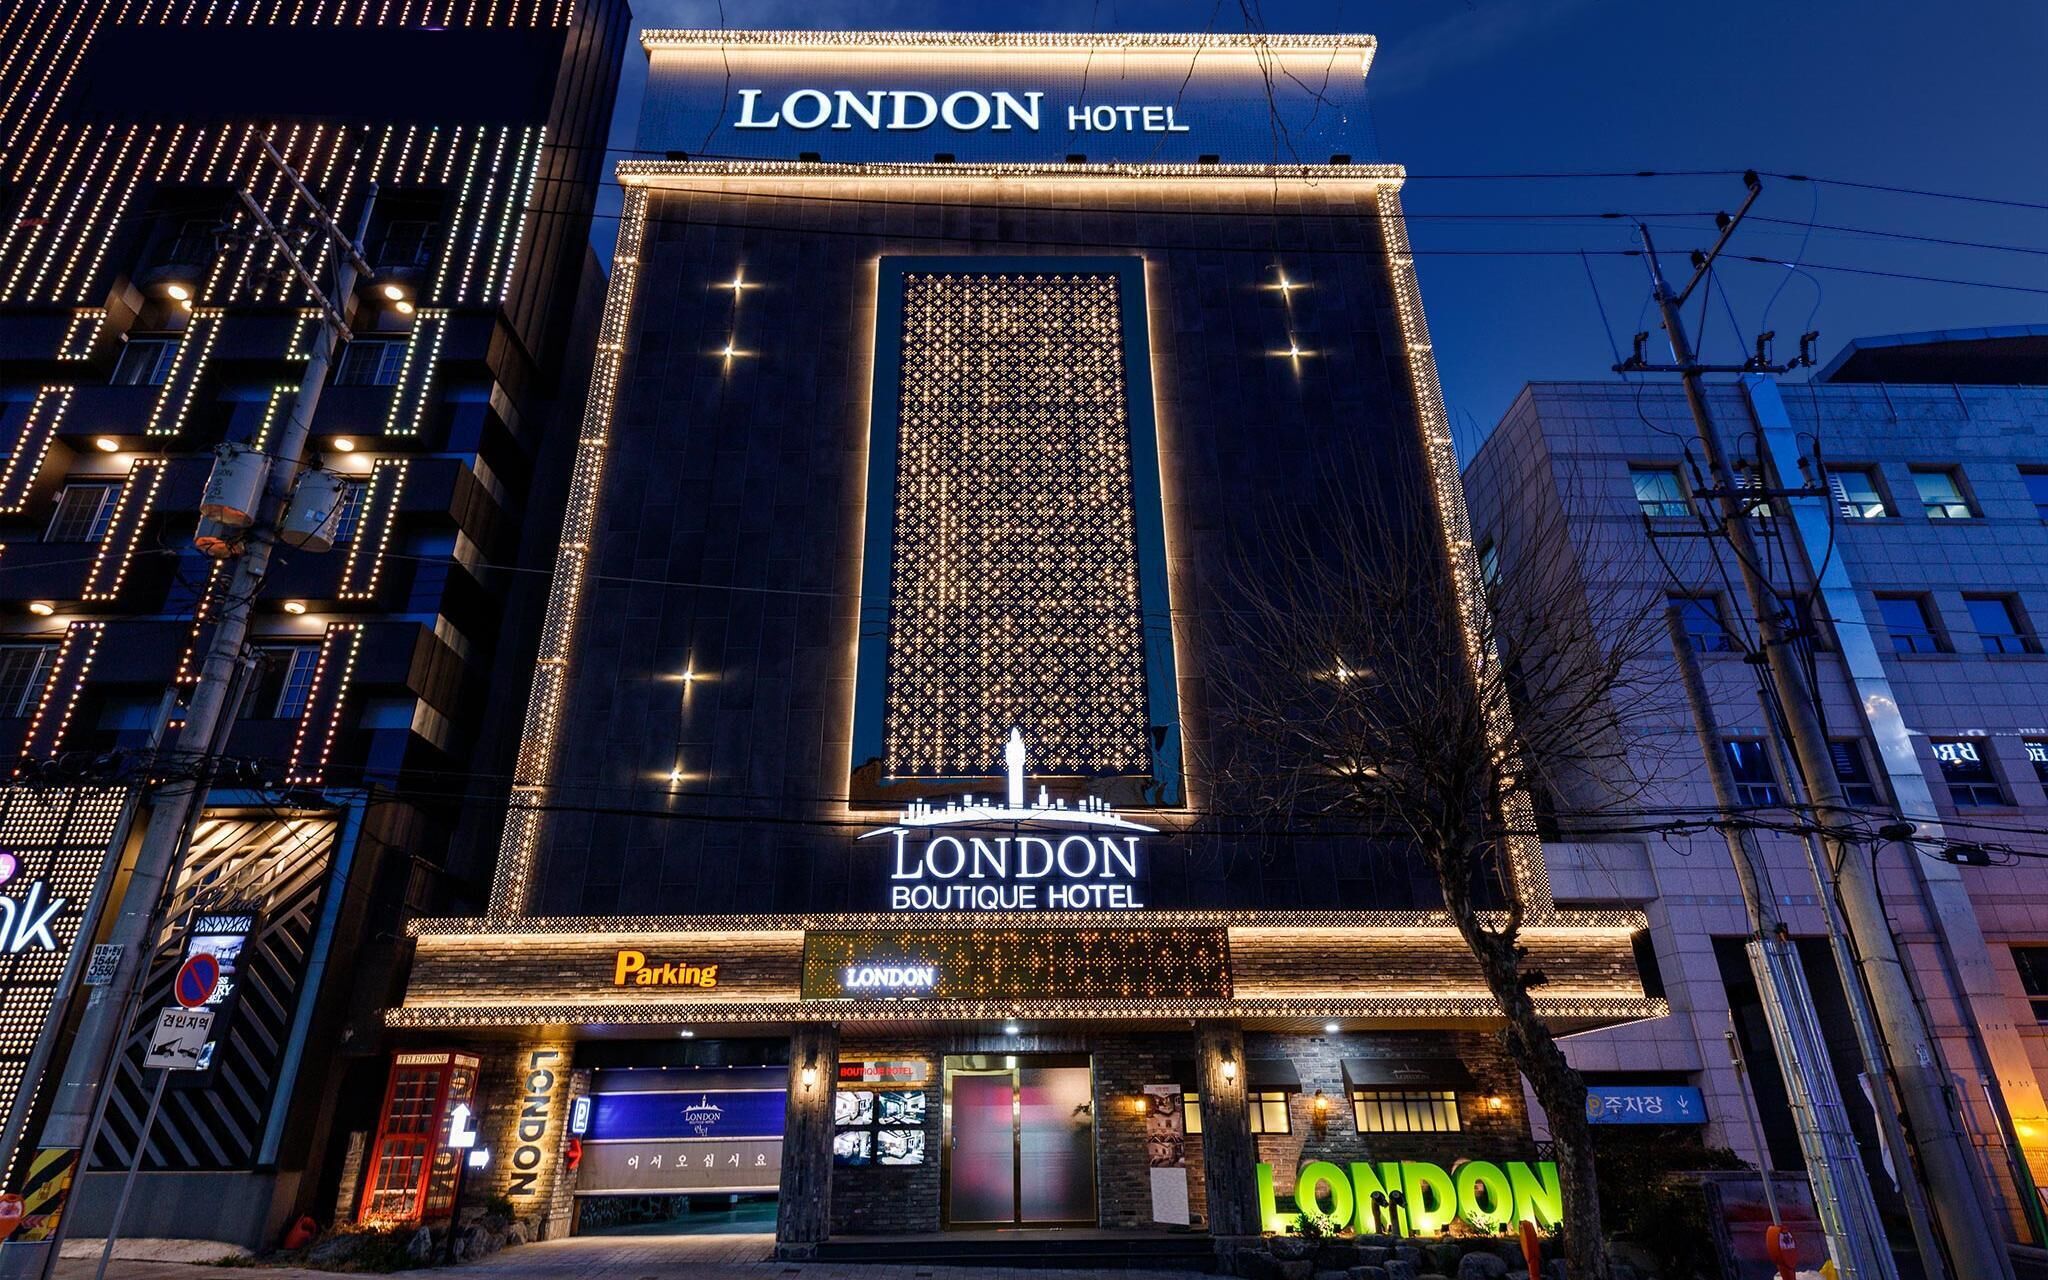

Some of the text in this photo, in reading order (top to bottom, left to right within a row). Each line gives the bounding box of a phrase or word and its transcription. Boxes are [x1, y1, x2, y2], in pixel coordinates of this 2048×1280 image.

[734, 88, 1190, 132] LONDON HOTEL
[891, 829, 1140, 879] LONDON
[892, 884, 1144, 910] BOUTIQUE HOTEL
[613, 950, 718, 988] Parking
[846, 966, 934, 988] LONDON
[163, 1014, 210, 1031] 견인지역
[399, 1053, 447, 1065] TELEPHONE
[840, 1066, 885, 1077] BOUTIQUE
[685, 1111, 721, 1121] LONDON
[1604, 1096, 1663, 1114] 주차장
[508, 1050, 559, 1196] LONDON
[1256, 1160, 1563, 1238] LONDON
